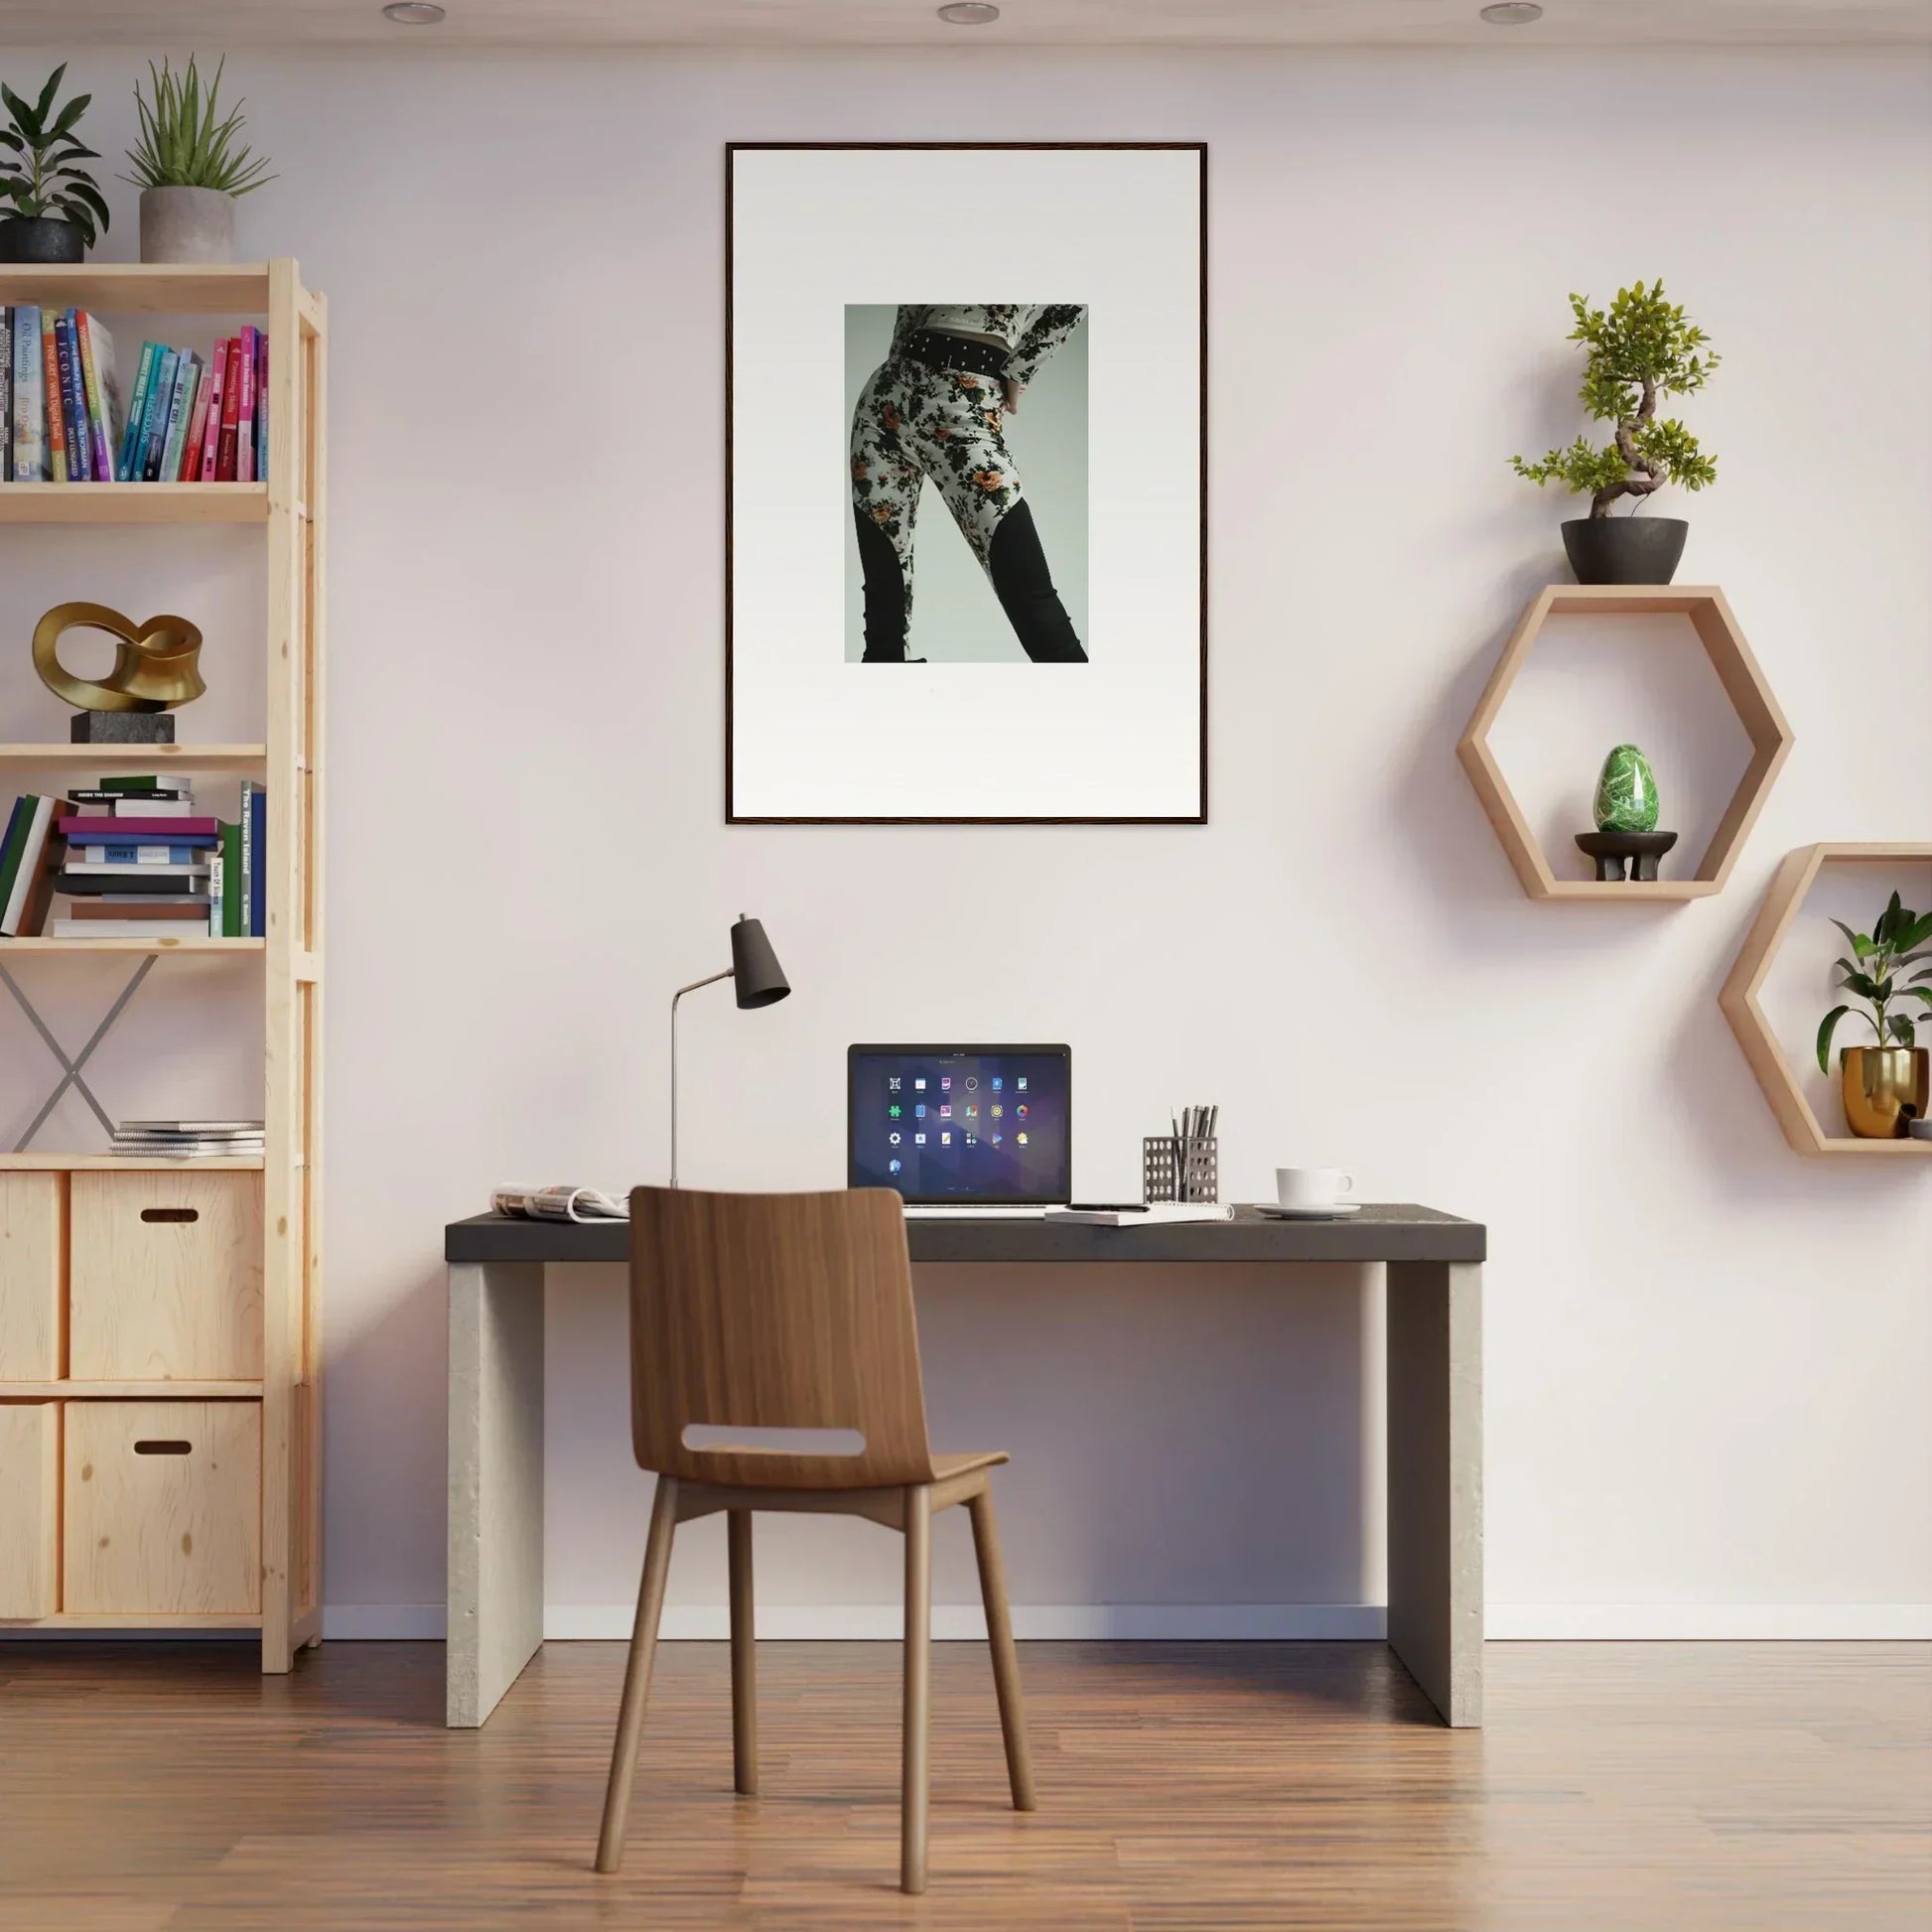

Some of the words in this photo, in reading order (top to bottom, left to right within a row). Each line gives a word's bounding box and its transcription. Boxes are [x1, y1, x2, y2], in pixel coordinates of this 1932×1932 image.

[21, 323, 33, 336] Oil
[19, 340, 32, 382] Paintings
[46, 344, 55, 361] FINE
[47, 361, 56, 376] ART
[60, 343, 72, 404] ICONIC
[79, 325, 90, 370] Watercolor
[86, 371, 97, 408] Portraits
[228, 360, 238, 393] Parenting
[49, 382, 58, 398] With
[48, 399, 60, 421] Digital
[227, 394, 236, 413] Skills
[141, 393, 155, 444] SUCCESSFUL
[52, 422, 61, 439] Tools
